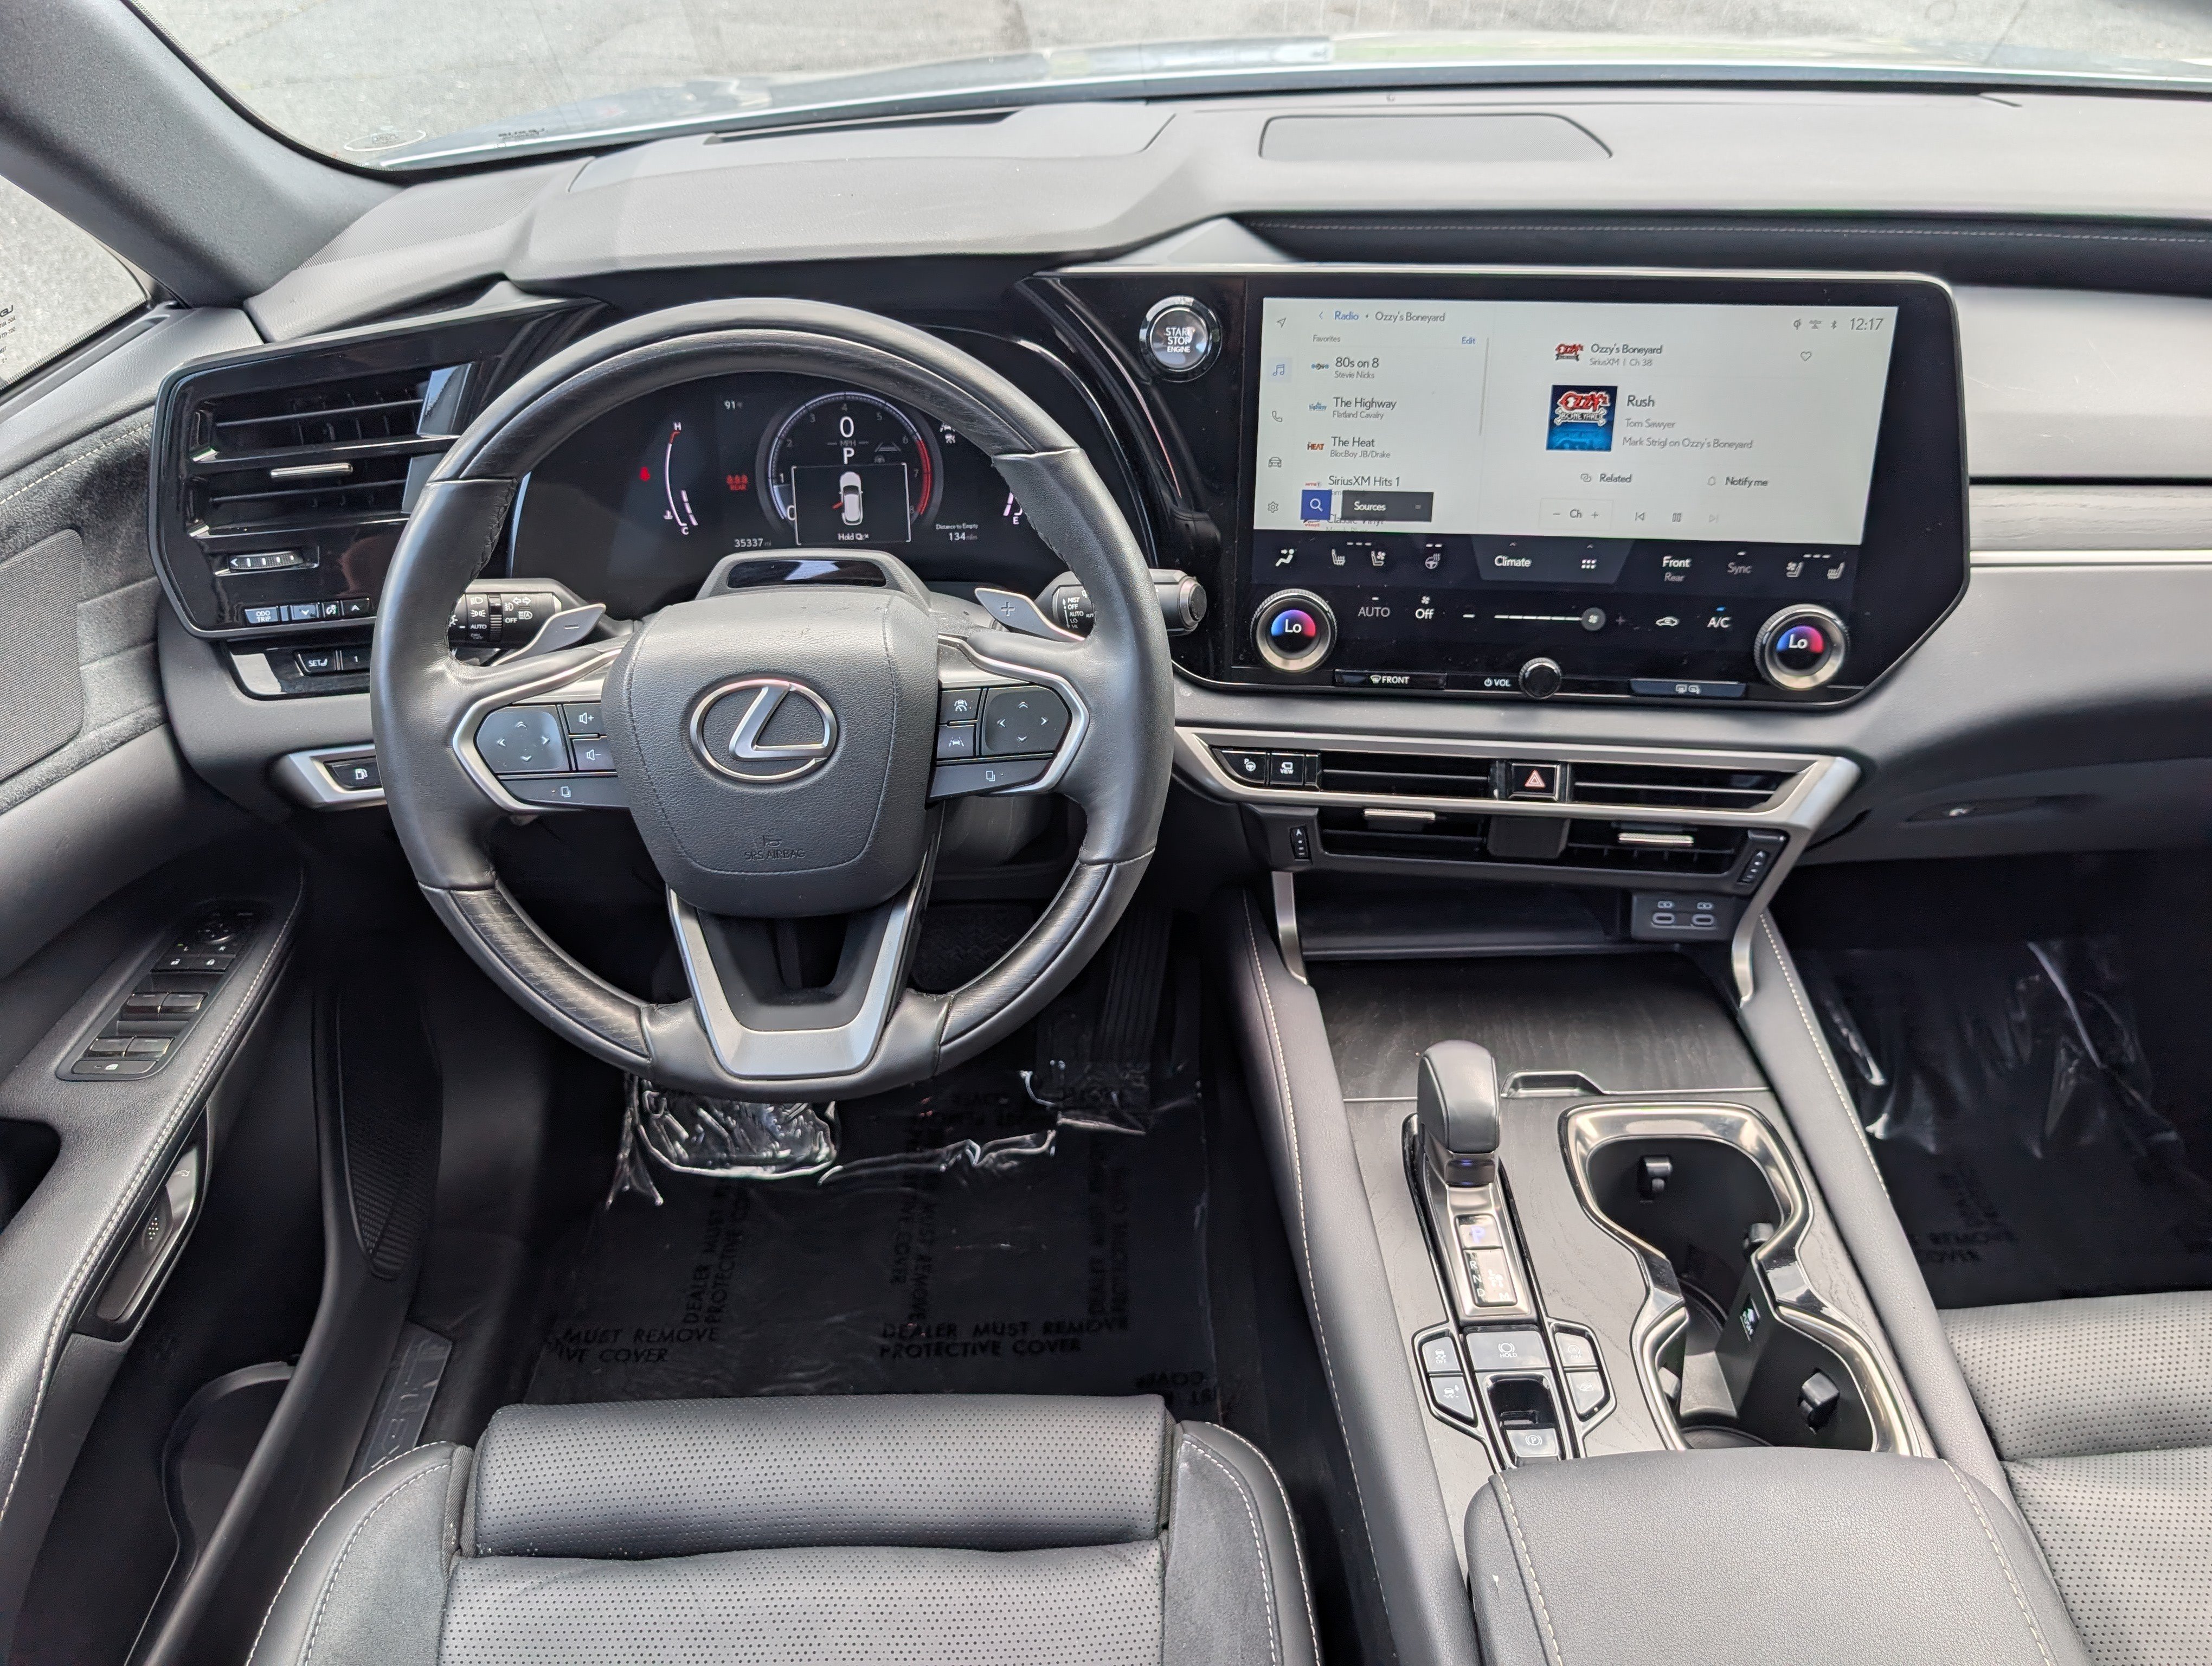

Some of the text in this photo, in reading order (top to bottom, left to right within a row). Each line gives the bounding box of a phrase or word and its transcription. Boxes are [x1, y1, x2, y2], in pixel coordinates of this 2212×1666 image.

[1334, 311, 1446, 323] Radio Ozzy's Boneyard
[1850, 318, 1883, 330] 12:17
[1166, 327, 1195, 336] START
[1167, 336, 1192, 345] STOP
[1461, 336, 1476, 345] Edit
[1591, 343, 1662, 356] Ozzy's Boneyard
[1335, 357, 1354, 368] 80s
[1372, 357, 1379, 368] 8
[1589, 358, 1653, 367] SiriusXM Ch 38
[1333, 397, 1398, 410] The Highway
[1627, 395, 1655, 407] Rush
[876, 413, 883, 421] 5
[1332, 411, 1384, 420] Flatland Cavalry
[673, 422, 681, 431] H
[840, 415, 854, 438] 0
[1625, 419, 1676, 430] Tom Sawyer
[902, 435, 909, 444] 6
[1331, 436, 1375, 447] The Heat
[1623, 437, 1644, 447] Mark
[1646, 438, 1668, 448] Strigl
[1682, 438, 1711, 450] Ozzy's
[1713, 439, 1753, 451] Boneyard
[843, 447, 854, 464] P
[1330, 450, 1391, 459] BlocBoy JB/Drake
[1328, 476, 1400, 487] SiriusXM Hits 1
[1599, 473, 1632, 483] Related
[1725, 477, 1752, 488] Notify
[1354, 501, 1386, 511] Sources
[1570, 509, 1583, 519] Ch
[1013, 516, 1019, 524] E
[681, 526, 689, 535] C
[838, 533, 854, 541] Hold
[949, 532, 966, 541] 134
[735, 538, 763, 548] 35337
[1495, 556, 1532, 567] Climate
[1662, 556, 1691, 568] Front
[1727, 562, 1752, 575] Sync
[1664, 572, 1685, 582] Rear
[1358, 607, 1391, 618] AUTO
[1415, 608, 1434, 620] Off
[1285, 619, 1302, 634] Lo
[1707, 616, 1732, 629] A/C
[1789, 635, 1808, 649] Lo
[308, 659, 321, 667] SET
[1382, 676, 1410, 684] FRONT
[1494, 678, 1511, 687] VOL
[744, 849, 806, 861] SRS AIRBAG
[1470, 1226, 1485, 1244] P
[1469, 1260, 1478, 1270] R
[1472, 1274, 1482, 1283] N
[1476, 1288, 1486, 1297] D
[1499, 1292, 1510, 1300] M
[882, 1316, 1128, 1339] DEALER MUST REMOVE
[564, 1328, 720, 1345] MUST REMOVE
[879, 1337, 1082, 1359] PROTECTIVE COVER
[599, 1348, 668, 1363] COVER
